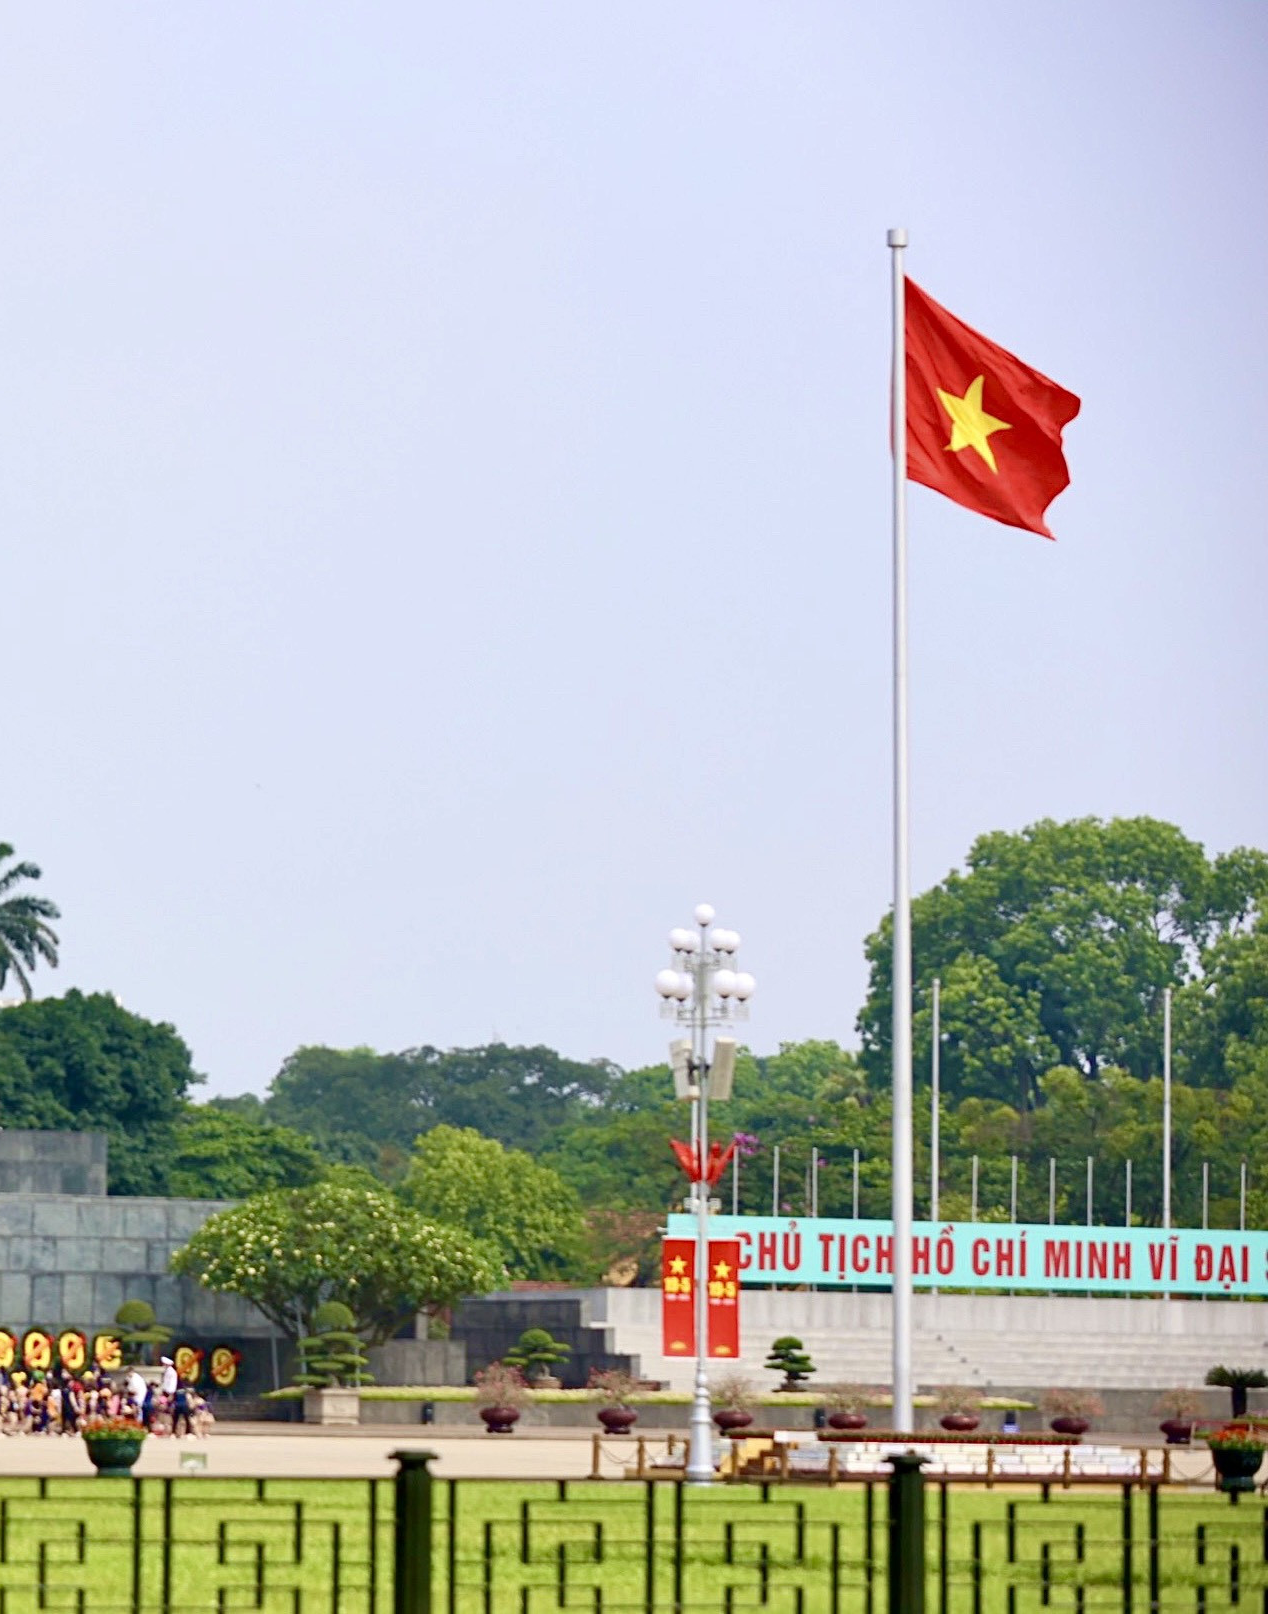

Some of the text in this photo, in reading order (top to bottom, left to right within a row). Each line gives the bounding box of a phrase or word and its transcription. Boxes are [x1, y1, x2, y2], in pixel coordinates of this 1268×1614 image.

[735, 1220, 801, 1271] CHỦ
[819, 1233, 894, 1281] TỊCH
[912, 1224, 954, 1275] HỒ
[972, 1230, 1027, 1277] CHÍ
[1044, 1239, 1131, 1280] MINH
[1148, 1235, 1180, 1281] VĨ
[1194, 1244, 1250, 1290] ĐẠI
